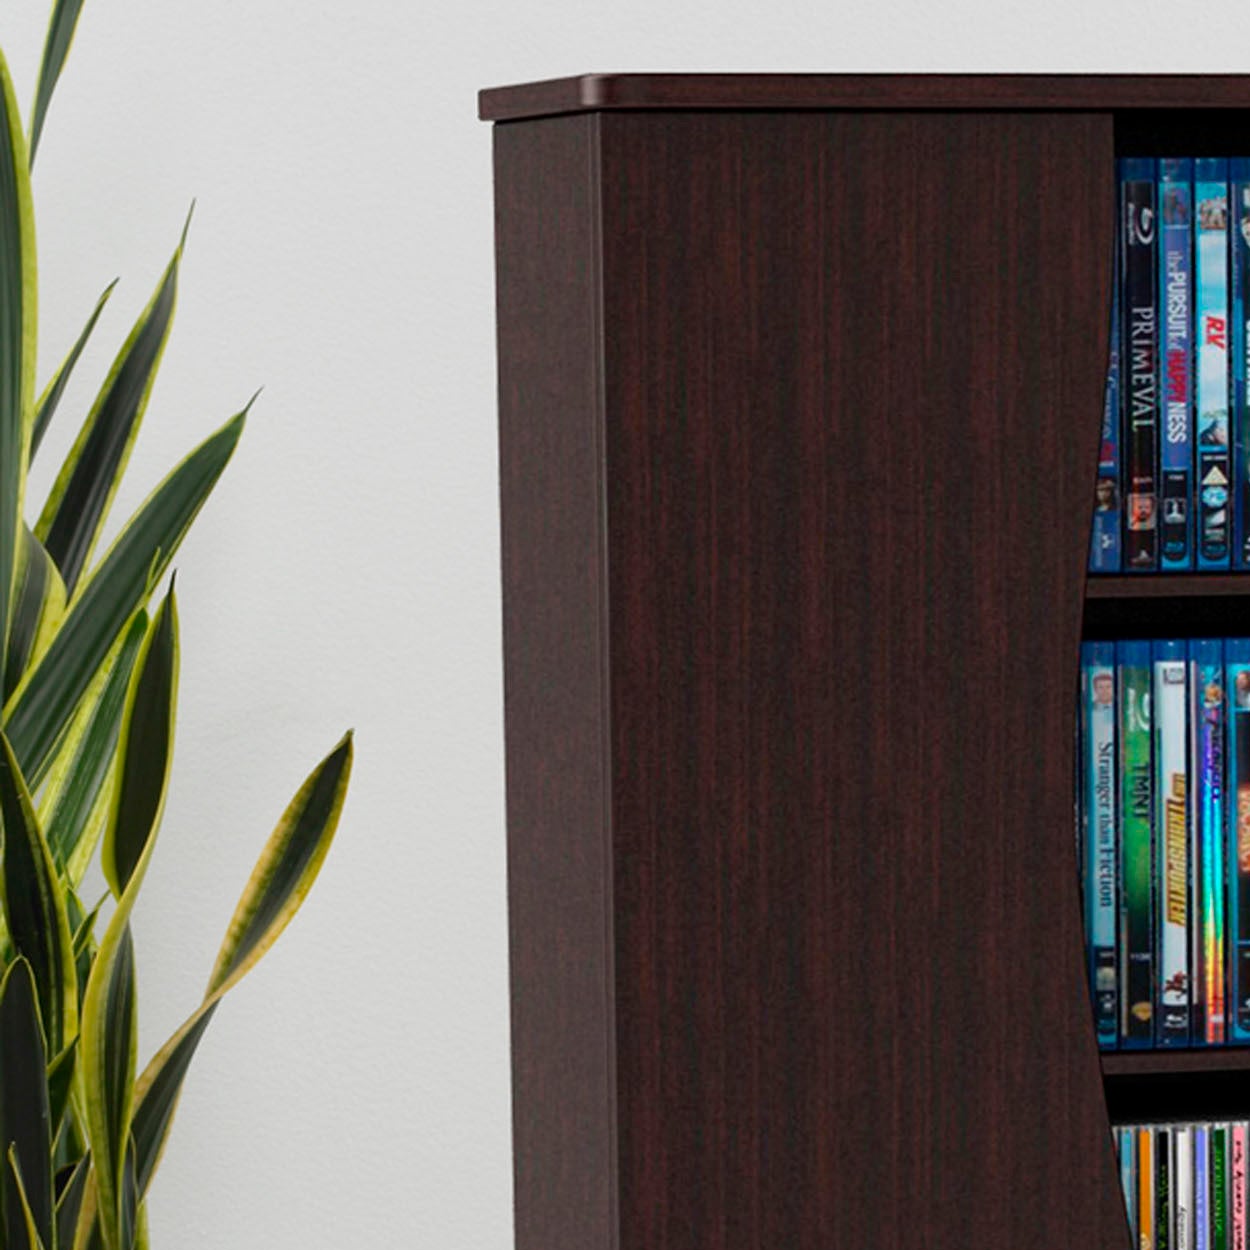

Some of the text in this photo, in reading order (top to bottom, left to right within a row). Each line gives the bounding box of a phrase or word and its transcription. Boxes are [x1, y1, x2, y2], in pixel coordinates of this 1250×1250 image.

[1167, 272, 1187, 339] PURSUIT
[1132, 307, 1154, 432] PRIMEVAL
[1096, 742, 1115, 908] Stranger than Fiction
[1131, 761, 1150, 820] TMNT
[1166, 799, 1187, 927] TRANSPORTER
